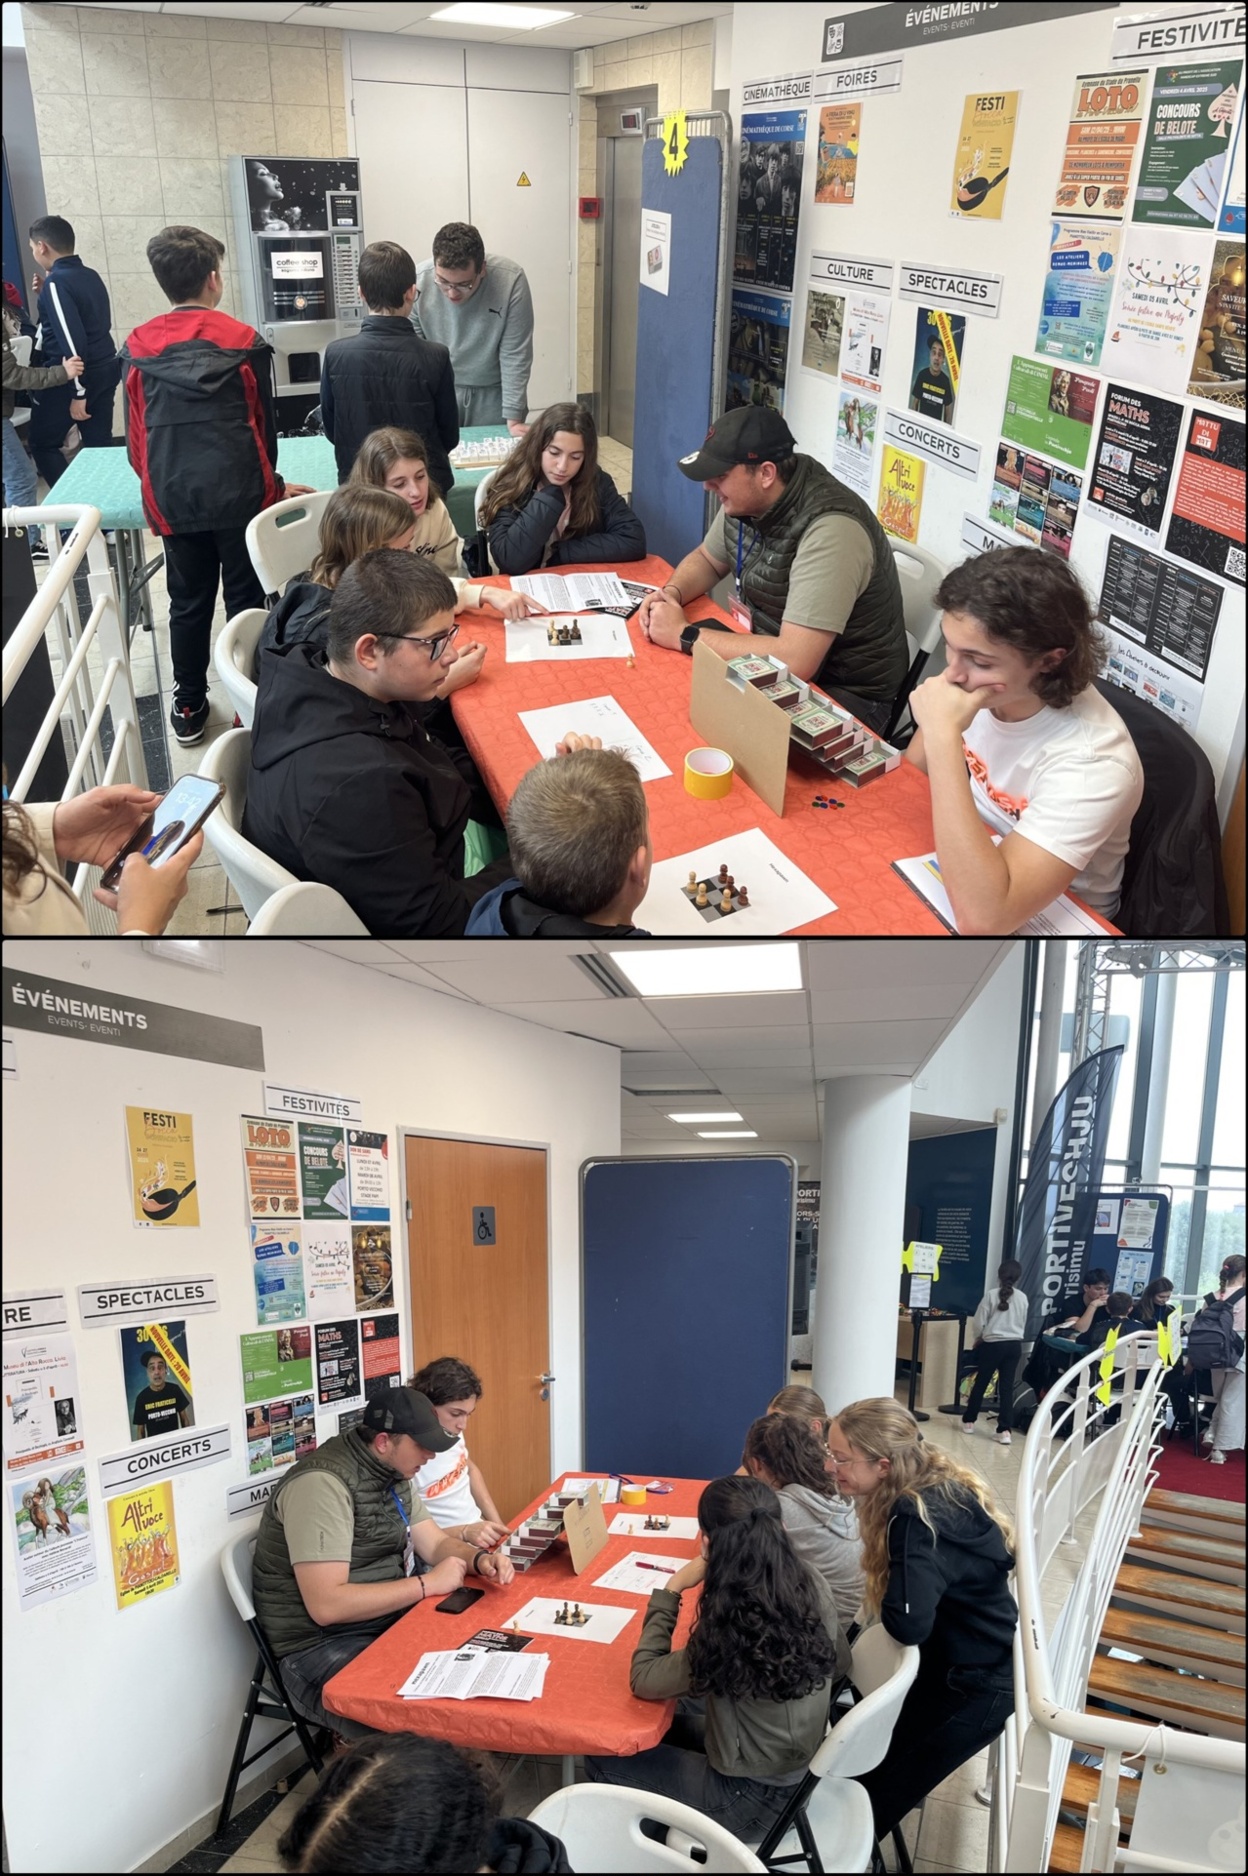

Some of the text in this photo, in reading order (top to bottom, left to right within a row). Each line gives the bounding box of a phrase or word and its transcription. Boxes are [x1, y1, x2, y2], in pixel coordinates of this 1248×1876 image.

[836, 70, 877, 88] FOIRES
[743, 81, 811, 101] CINÉMATHÈQUE
[1078, 84, 1138, 111] LOTO
[975, 96, 1005, 111] FESTI
[1156, 103, 1201, 118] CONCOURS
[1154, 120, 1197, 135] DE BELOTE
[669, 122, 678, 161] 4
[276, 258, 299, 266] coffee
[827, 263, 874, 281] CULTURE
[908, 273, 988, 298] SPECTACLES
[1132, 292, 1169, 305] SAMEDI 05 AVRIL
[1111, 392, 1142, 407] FORUM DES
[1108, 400, 1150, 424] MATHS
[898, 423, 960, 459] CONCERTS
[11, 982, 148, 1030] ÉVÉNEMENTS
[90, 1022, 121, 1036] EVENTI
[282, 1095, 350, 1116] FESTIVITÉS
[143, 1111, 177, 1128] FESTI
[247, 1125, 291, 1146] LOTO
[303, 1146, 328, 1157] CONCOURS
[304, 1156, 328, 1166] DE BELOTE
[1041, 1095, 1093, 1317] PORTIVECHJU
[96, 1285, 205, 1309] SPECTACLES
[4, 1306, 32, 1324] RE
[317, 1332, 342, 1343] MATHS
[149, 1325, 168, 1351] NOUVELLE
[176, 1369, 191, 1384] AVRIL
[127, 1438, 212, 1474] CONCERTS
[121, 1497, 153, 1533] Altri
[141, 1512, 163, 1530] voce
[128, 1564, 166, 1585] Gospel
